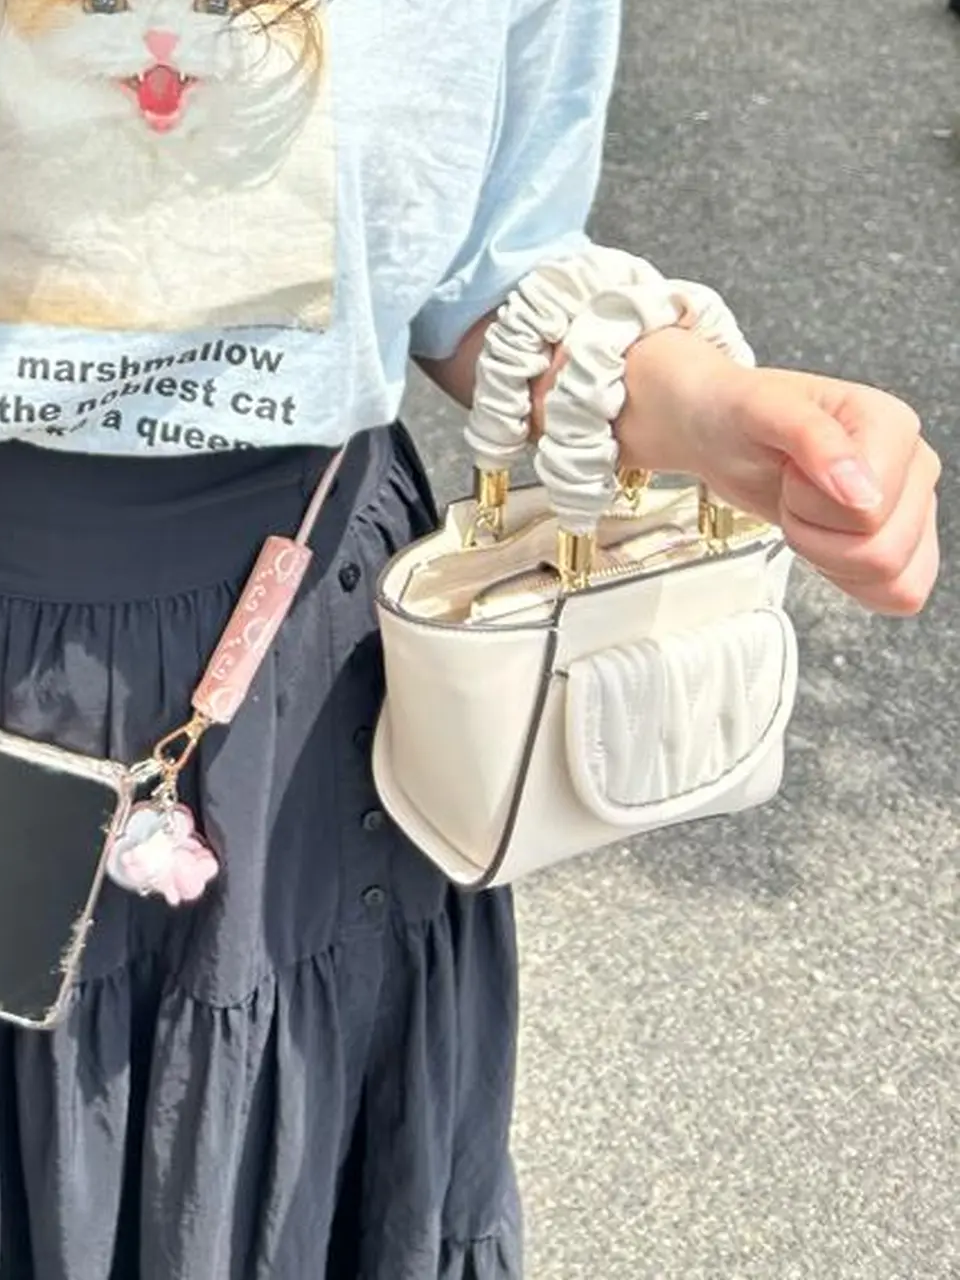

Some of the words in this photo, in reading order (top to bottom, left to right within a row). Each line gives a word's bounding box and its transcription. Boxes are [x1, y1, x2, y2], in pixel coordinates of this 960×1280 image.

[17, 339, 284, 383] marshmallow
[77, 376, 217, 415] noblest
[230, 391, 296, 426] cat
[101, 408, 122, 436] a
